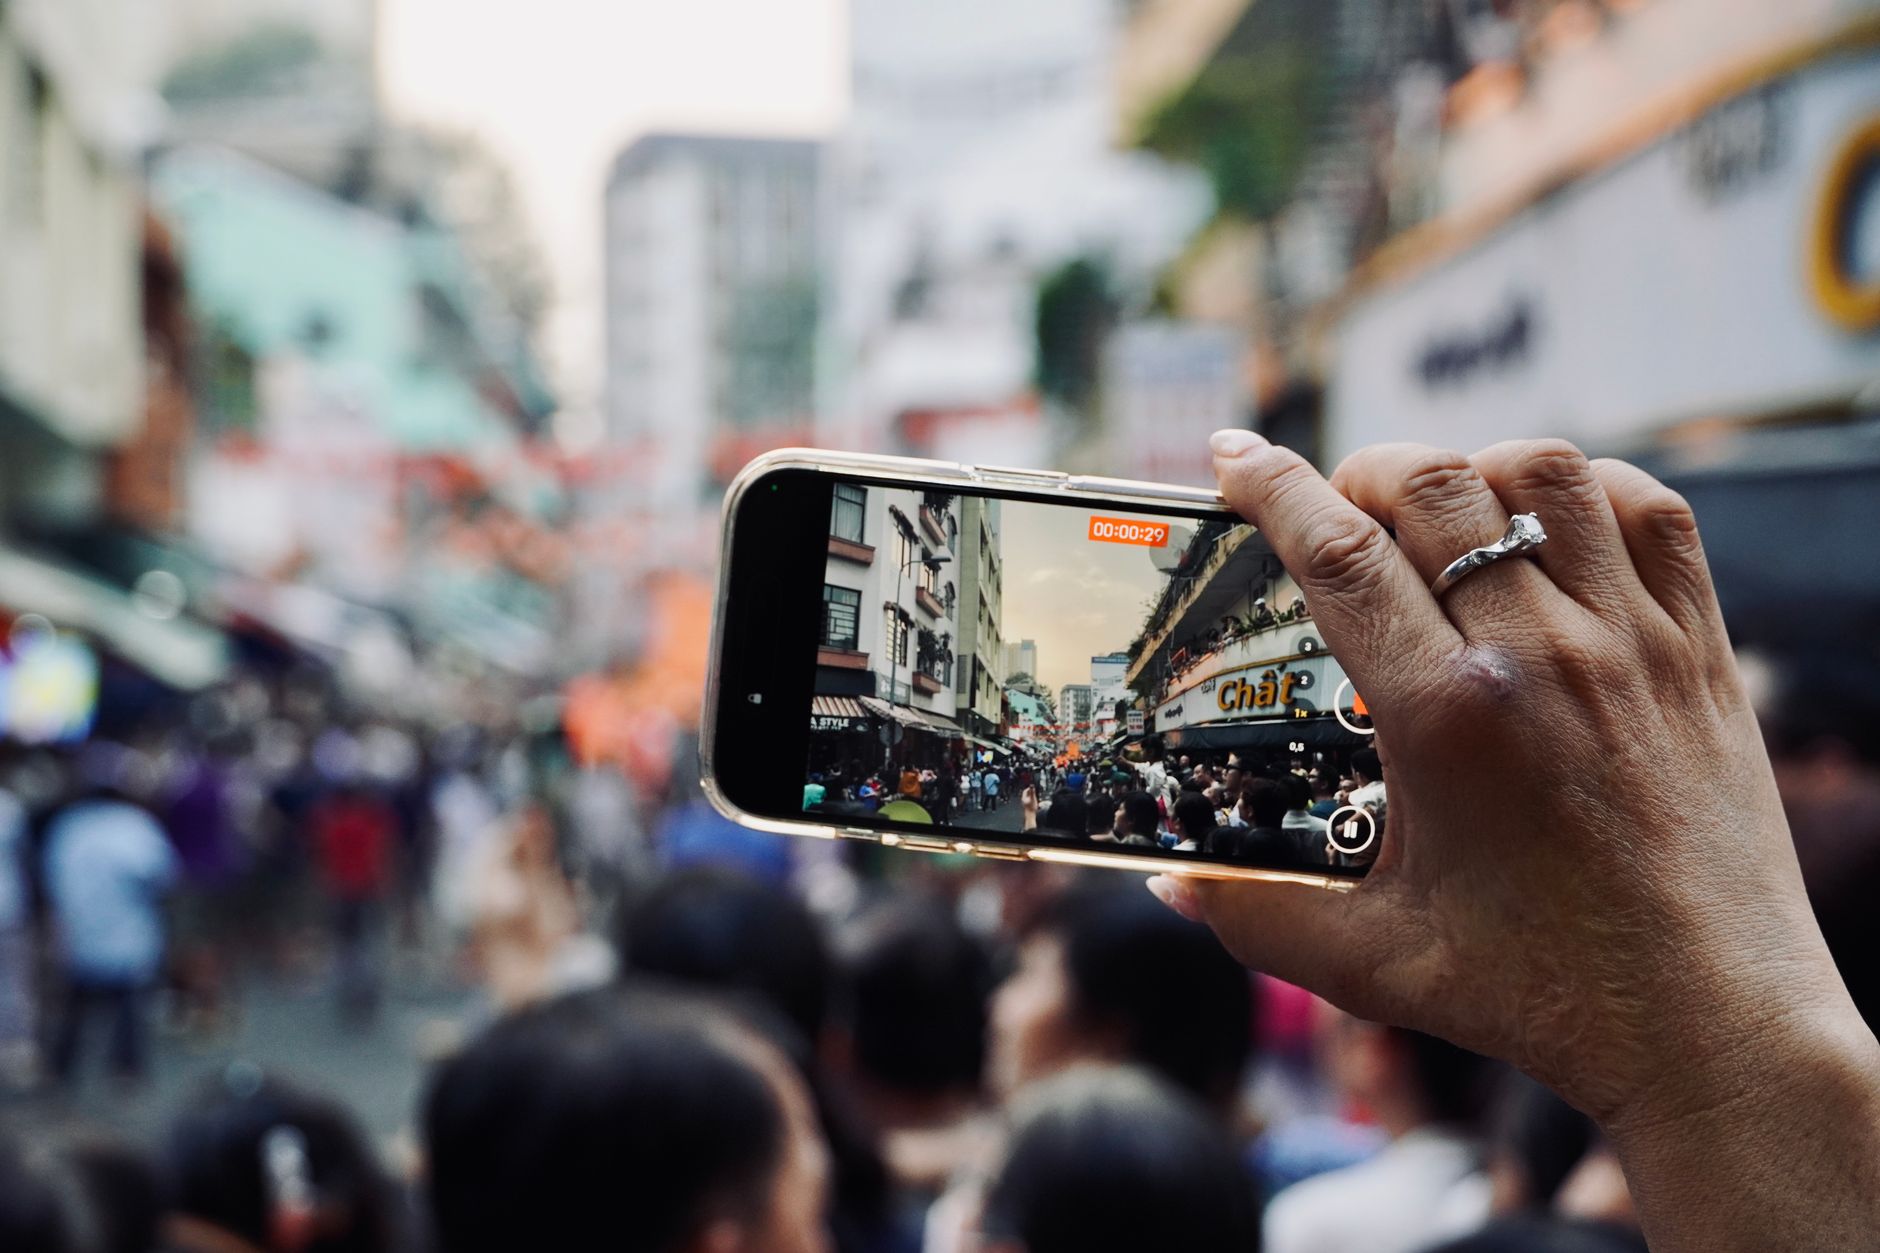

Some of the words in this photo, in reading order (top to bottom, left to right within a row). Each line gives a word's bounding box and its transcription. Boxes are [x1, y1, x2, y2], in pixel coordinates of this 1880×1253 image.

[1093, 522, 1165, 542] 00:00:29
[1304, 642, 1312, 652] 3
[1300, 675, 1308, 685] 2
[1217, 663, 1296, 711] Chất
[820, 718, 849, 727] STYLE
